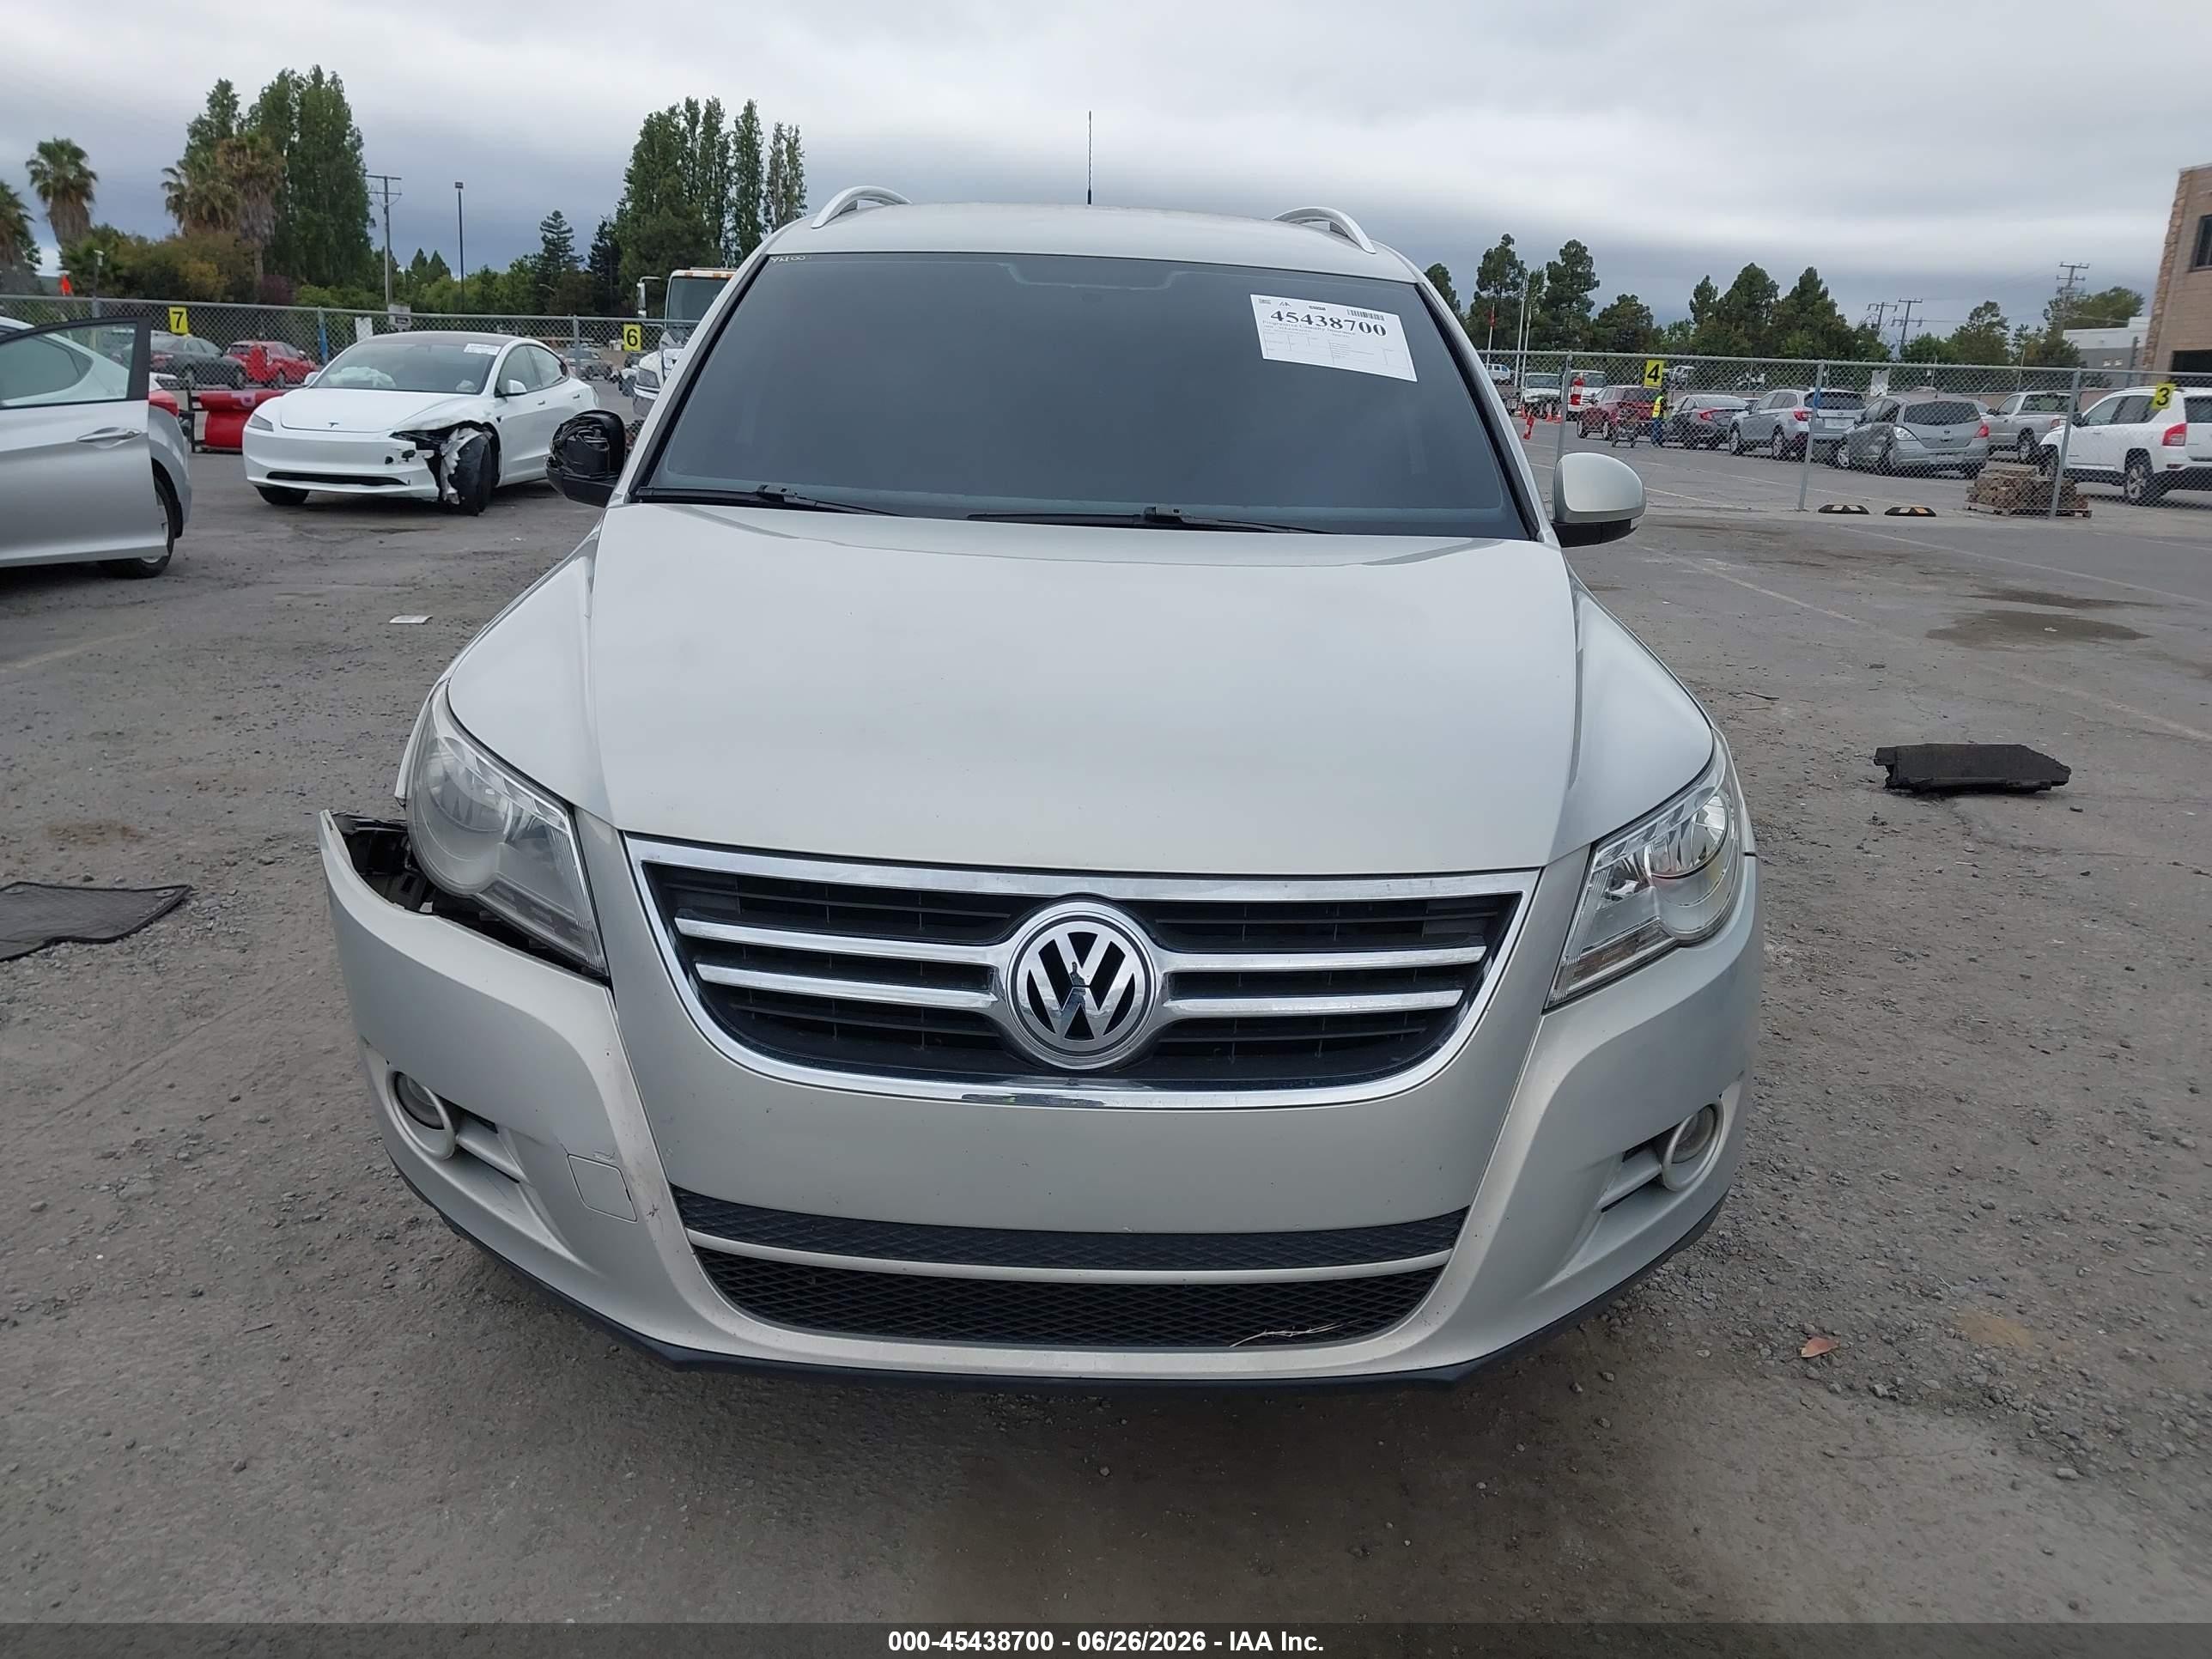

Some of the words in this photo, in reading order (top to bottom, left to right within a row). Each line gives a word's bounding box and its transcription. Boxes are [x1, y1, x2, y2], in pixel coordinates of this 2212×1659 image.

[172, 311, 184, 330] 7
[1270, 310, 1387, 337] 45438700
[627, 328, 638, 347] 6
[1646, 363, 1661, 383] 4
[2156, 386, 2170, 406] 3
[1017, 921, 1146, 1051] VW
